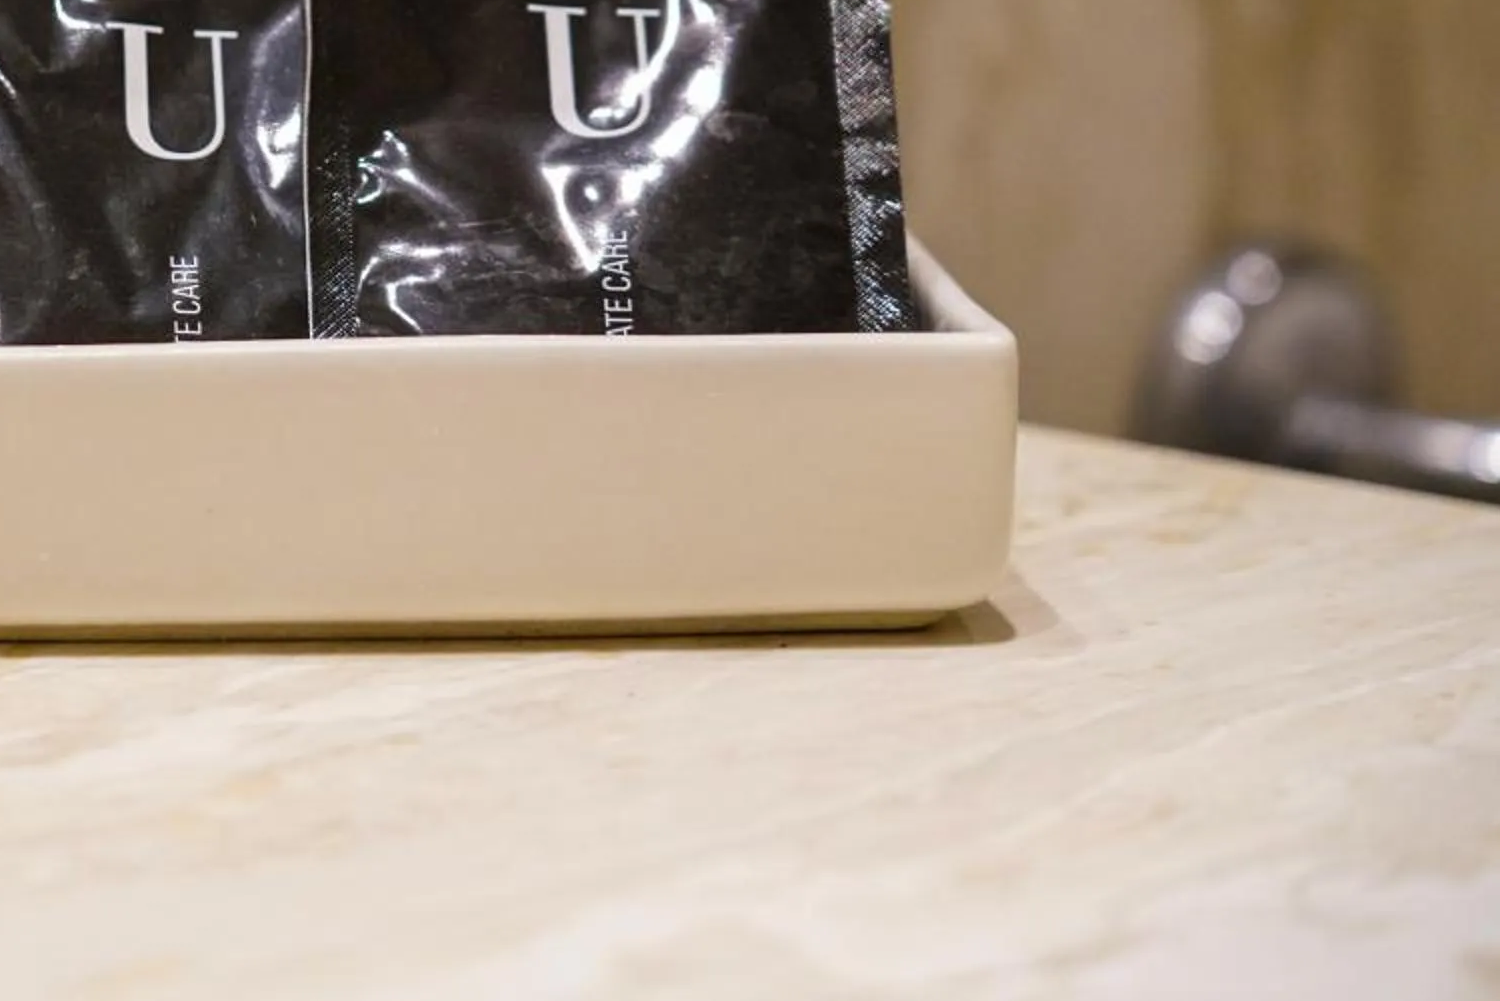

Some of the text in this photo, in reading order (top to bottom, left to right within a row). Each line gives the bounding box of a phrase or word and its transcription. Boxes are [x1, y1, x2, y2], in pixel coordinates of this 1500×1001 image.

[106, 20, 239, 161] U
[527, 3, 661, 139] U
[169, 255, 201, 315] CARE
[600, 230, 632, 292] CARE
